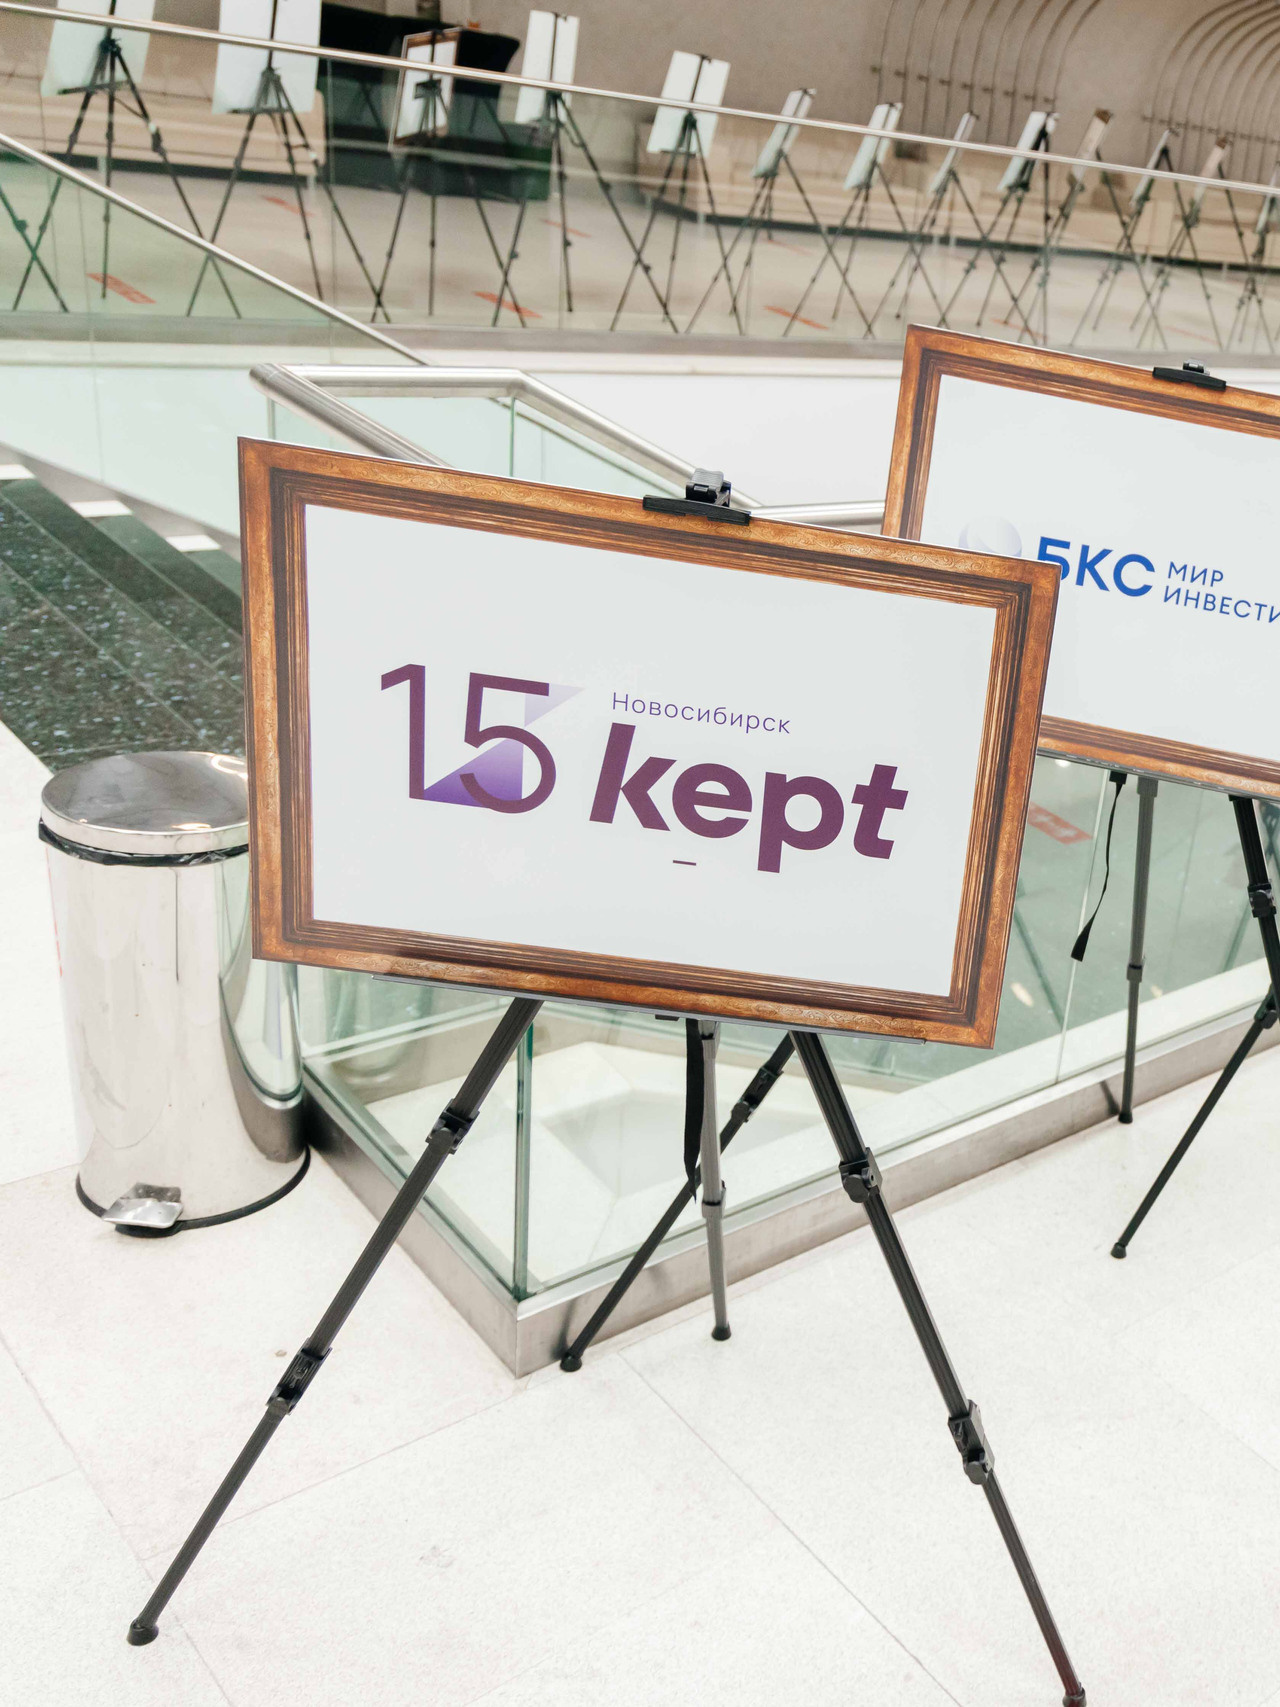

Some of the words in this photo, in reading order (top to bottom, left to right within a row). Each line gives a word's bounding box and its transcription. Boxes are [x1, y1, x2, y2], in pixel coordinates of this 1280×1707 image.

[1168, 561, 1224, 587] МИР
[381, 664, 556, 813] 15
[611, 691, 791, 735] Новосибирск
[589, 722, 908, 873] kept
